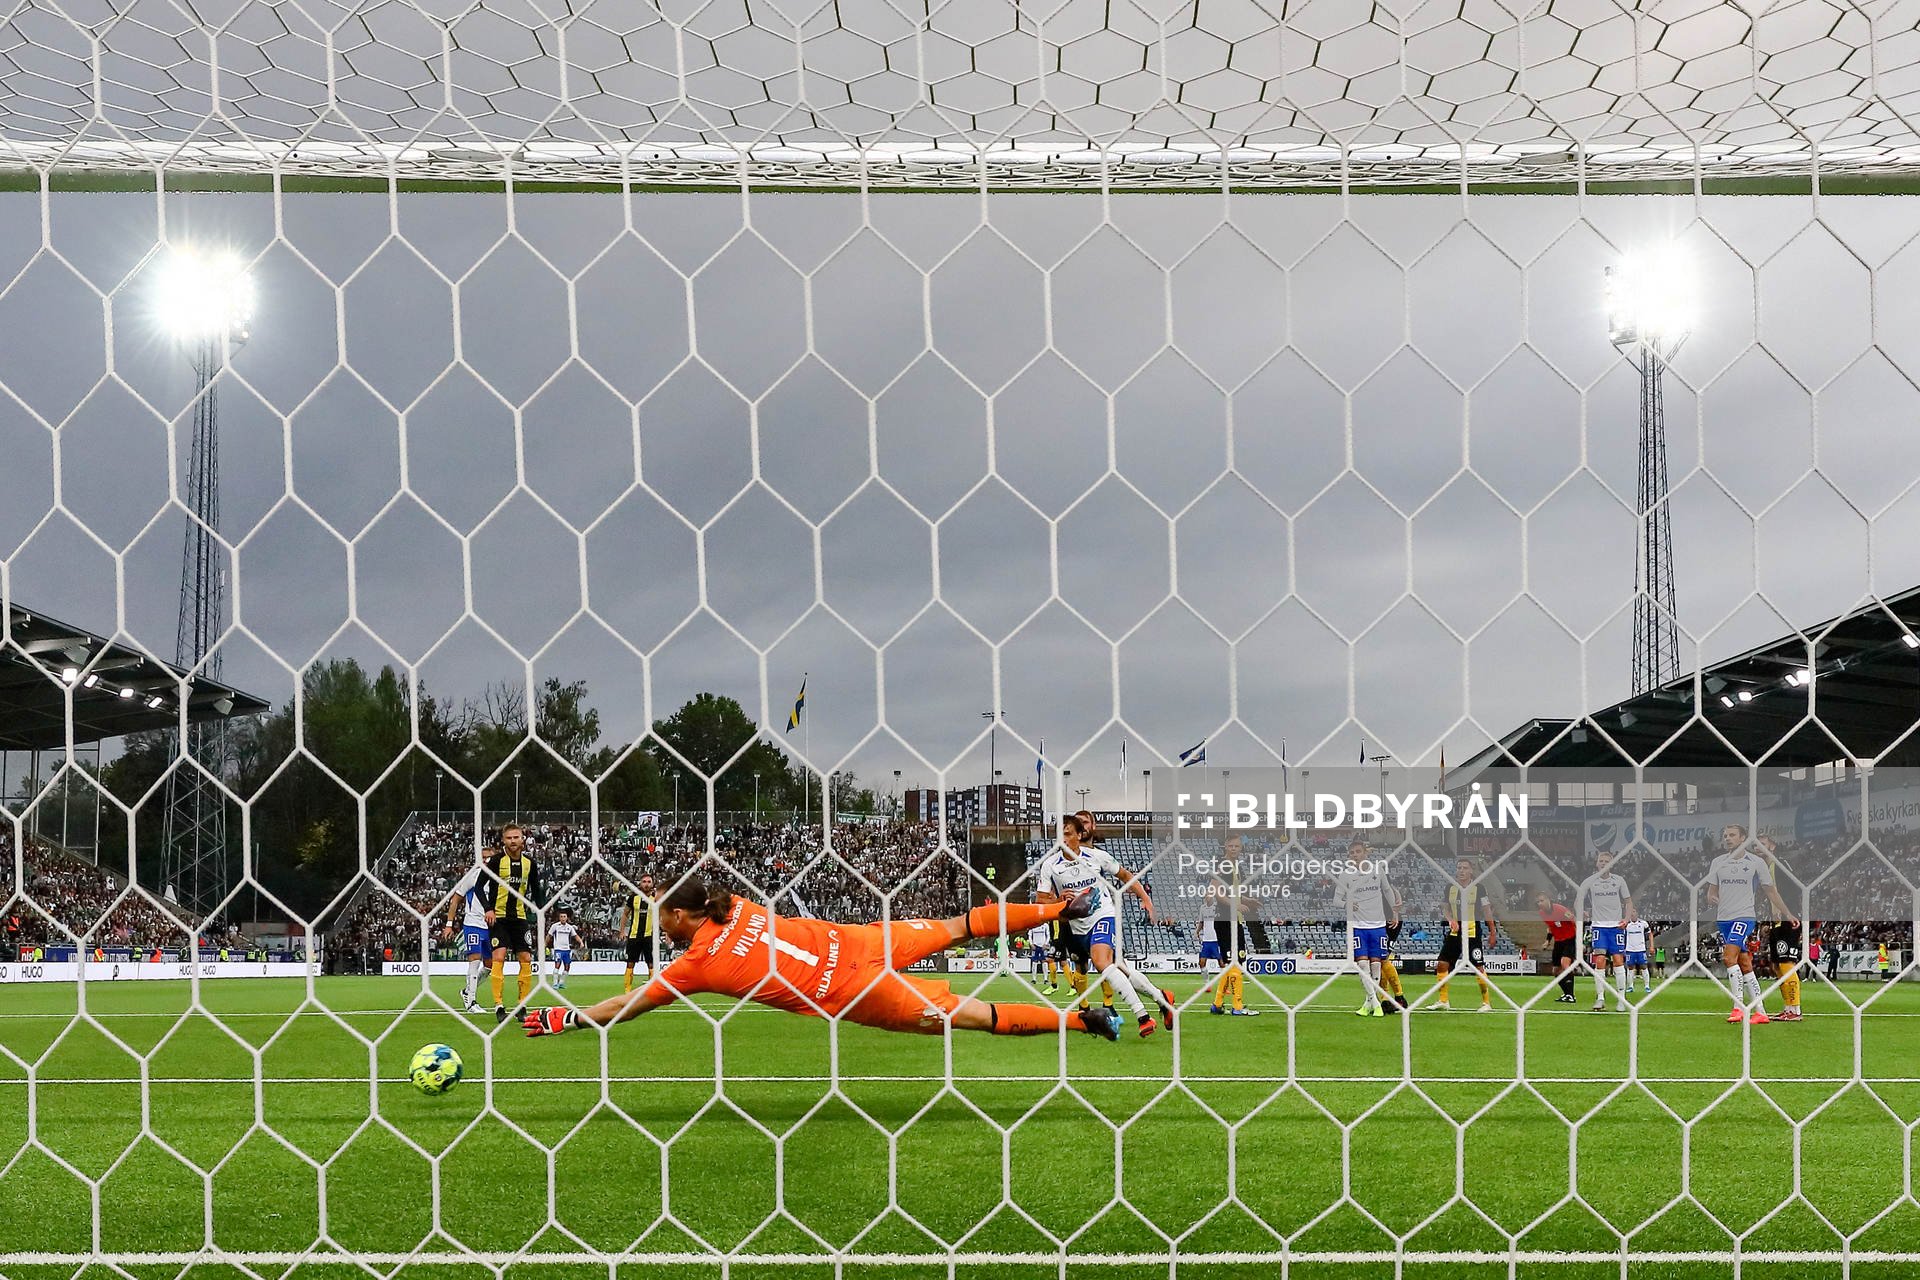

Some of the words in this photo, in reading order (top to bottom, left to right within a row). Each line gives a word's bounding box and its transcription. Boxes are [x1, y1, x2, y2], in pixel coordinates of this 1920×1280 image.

[1095, 813, 1104, 822] Vi
[1152, 813, 1175, 824] daga
[1846, 801, 1885, 825] Sveska
[1061, 877, 1097, 889] HOLMEN
[731, 913, 768, 958] WILAND
[759, 931, 820, 967] 1
[203, 965, 216, 975] HUGO
[391, 963, 420, 973] HUGO
[815, 969, 834, 999] SILJA
[826, 942, 840, 968] LINE
[976, 961, 988, 969] DS
[989, 961, 1014, 970] Smh
[1484, 962, 1518, 971] klingBil
[21, 966, 43, 979] HUGO
